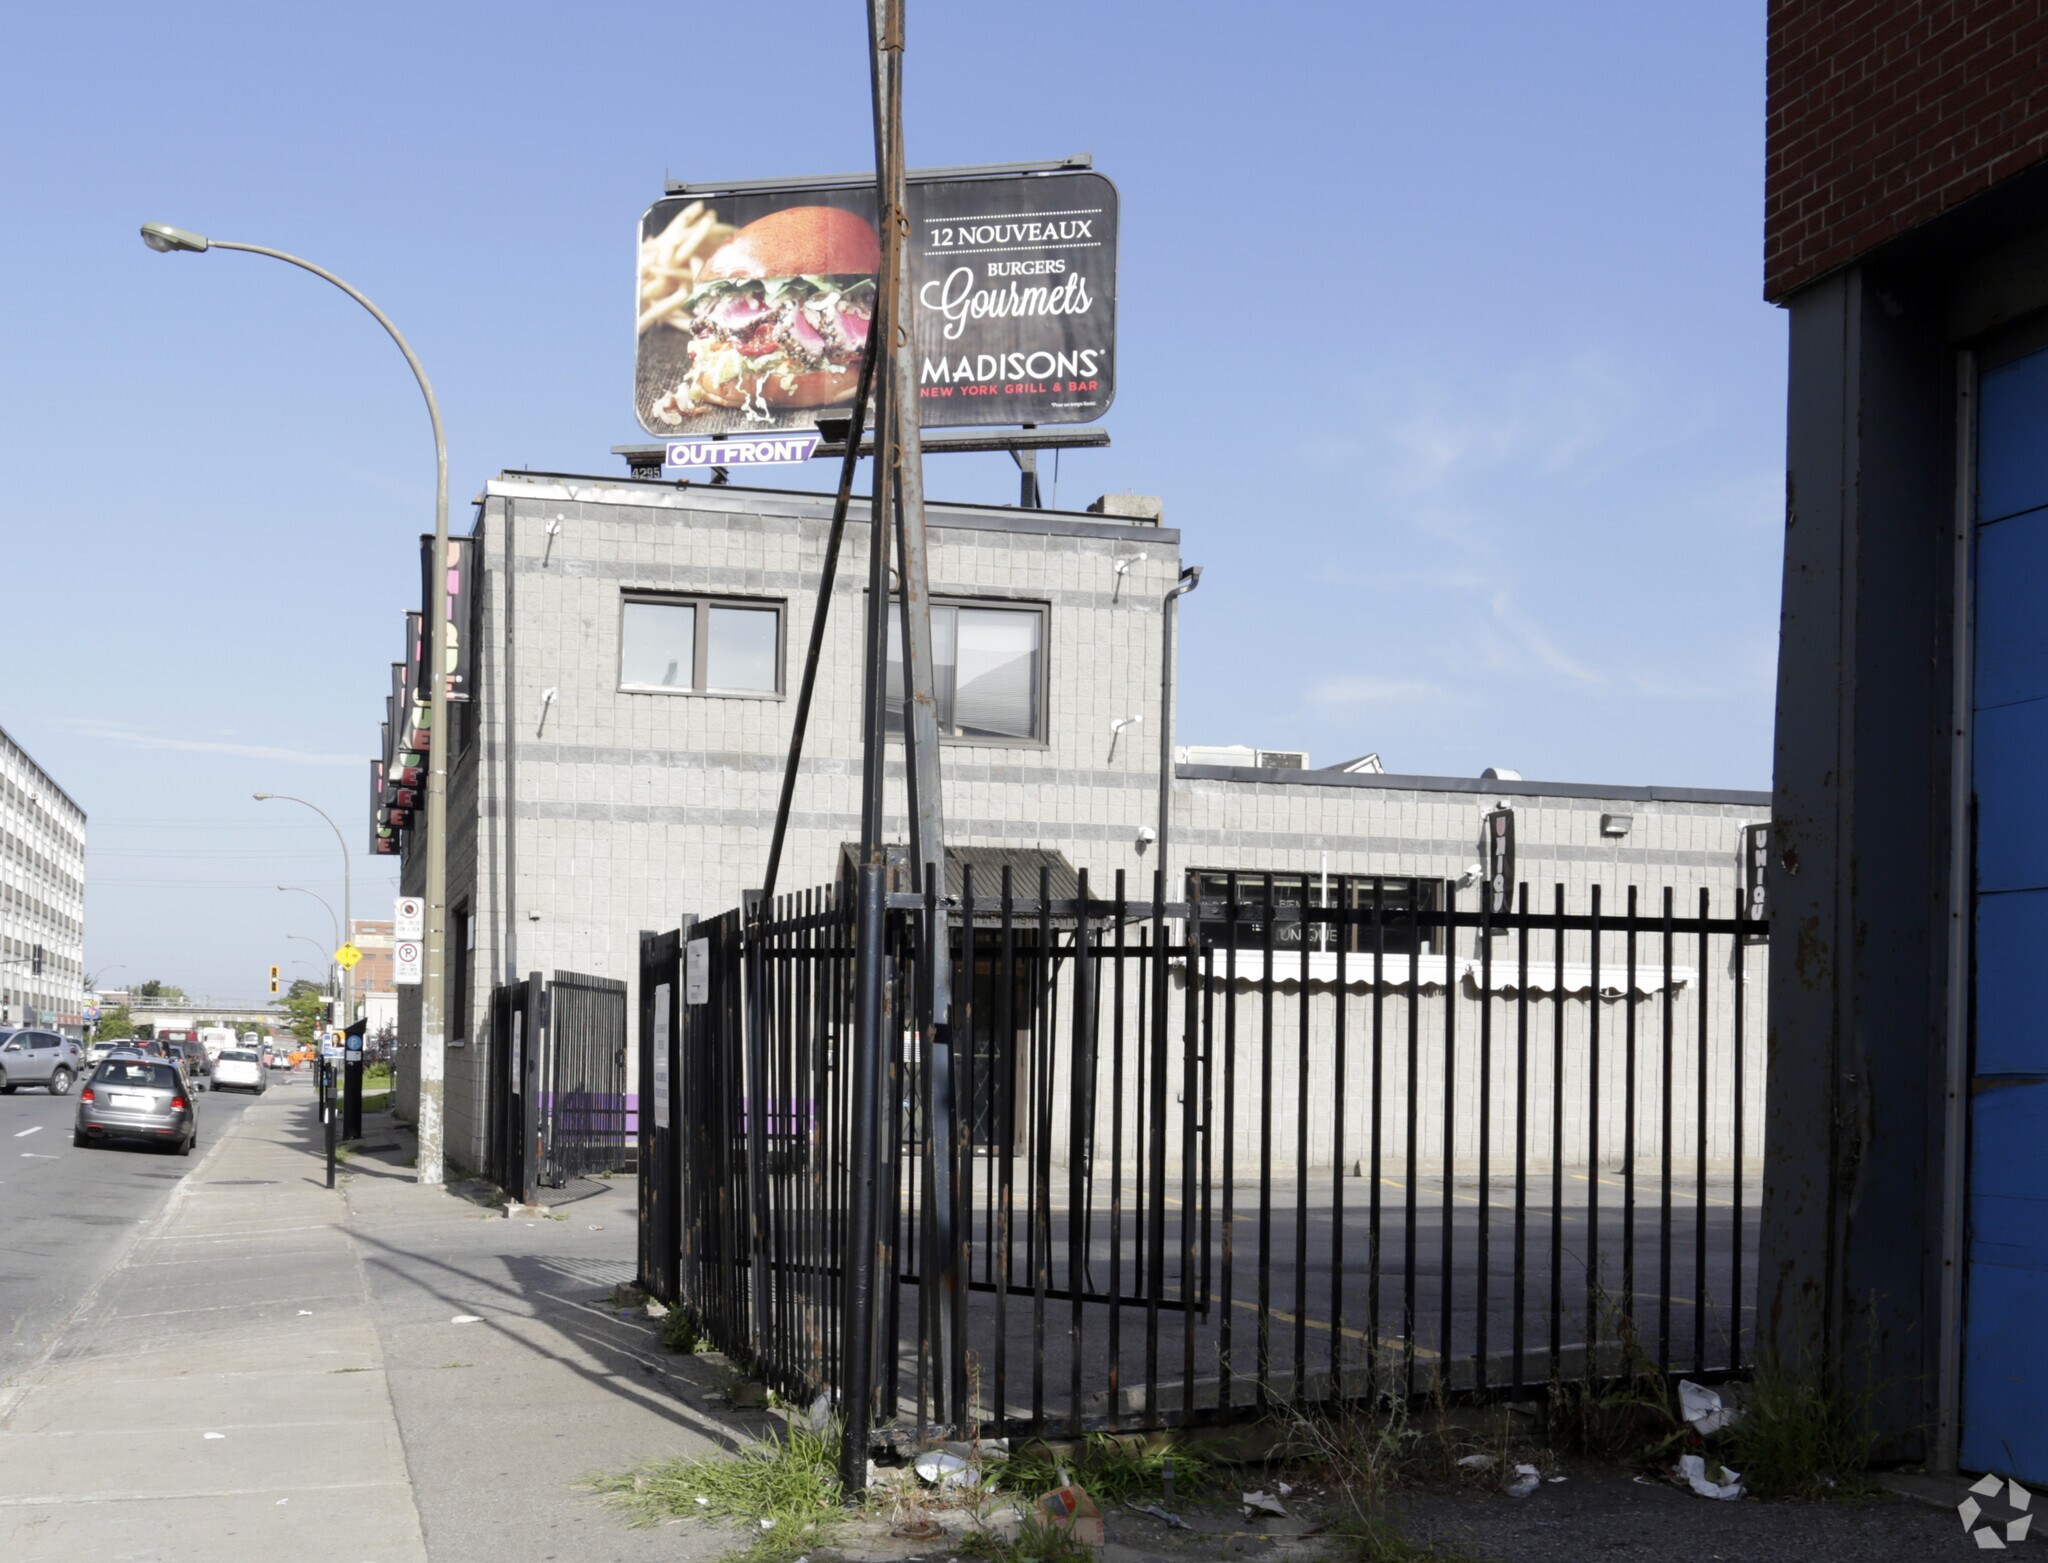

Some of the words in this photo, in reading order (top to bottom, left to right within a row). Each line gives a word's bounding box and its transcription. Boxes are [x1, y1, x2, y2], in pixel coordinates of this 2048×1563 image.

[931, 228, 953, 247] 12
[958, 220, 1092, 245] NOUVEAUX
[987, 260, 1065, 276] BURGERS
[920, 267, 1093, 339] Gourmets
[920, 387, 953, 397] NEW
[961, 385, 998, 395] YORK
[1005, 382, 1046, 394] GRILL
[1053, 382, 1061, 392] &
[1069, 381, 1098, 391] BAR
[671, 441, 810, 465] OUTFRONT
[631, 467, 660, 479] 4295
[1493, 816, 1506, 912] UNIQU
[1751, 830, 1767, 920] UNIQU
[1280, 928, 1338, 942] UNQUE
